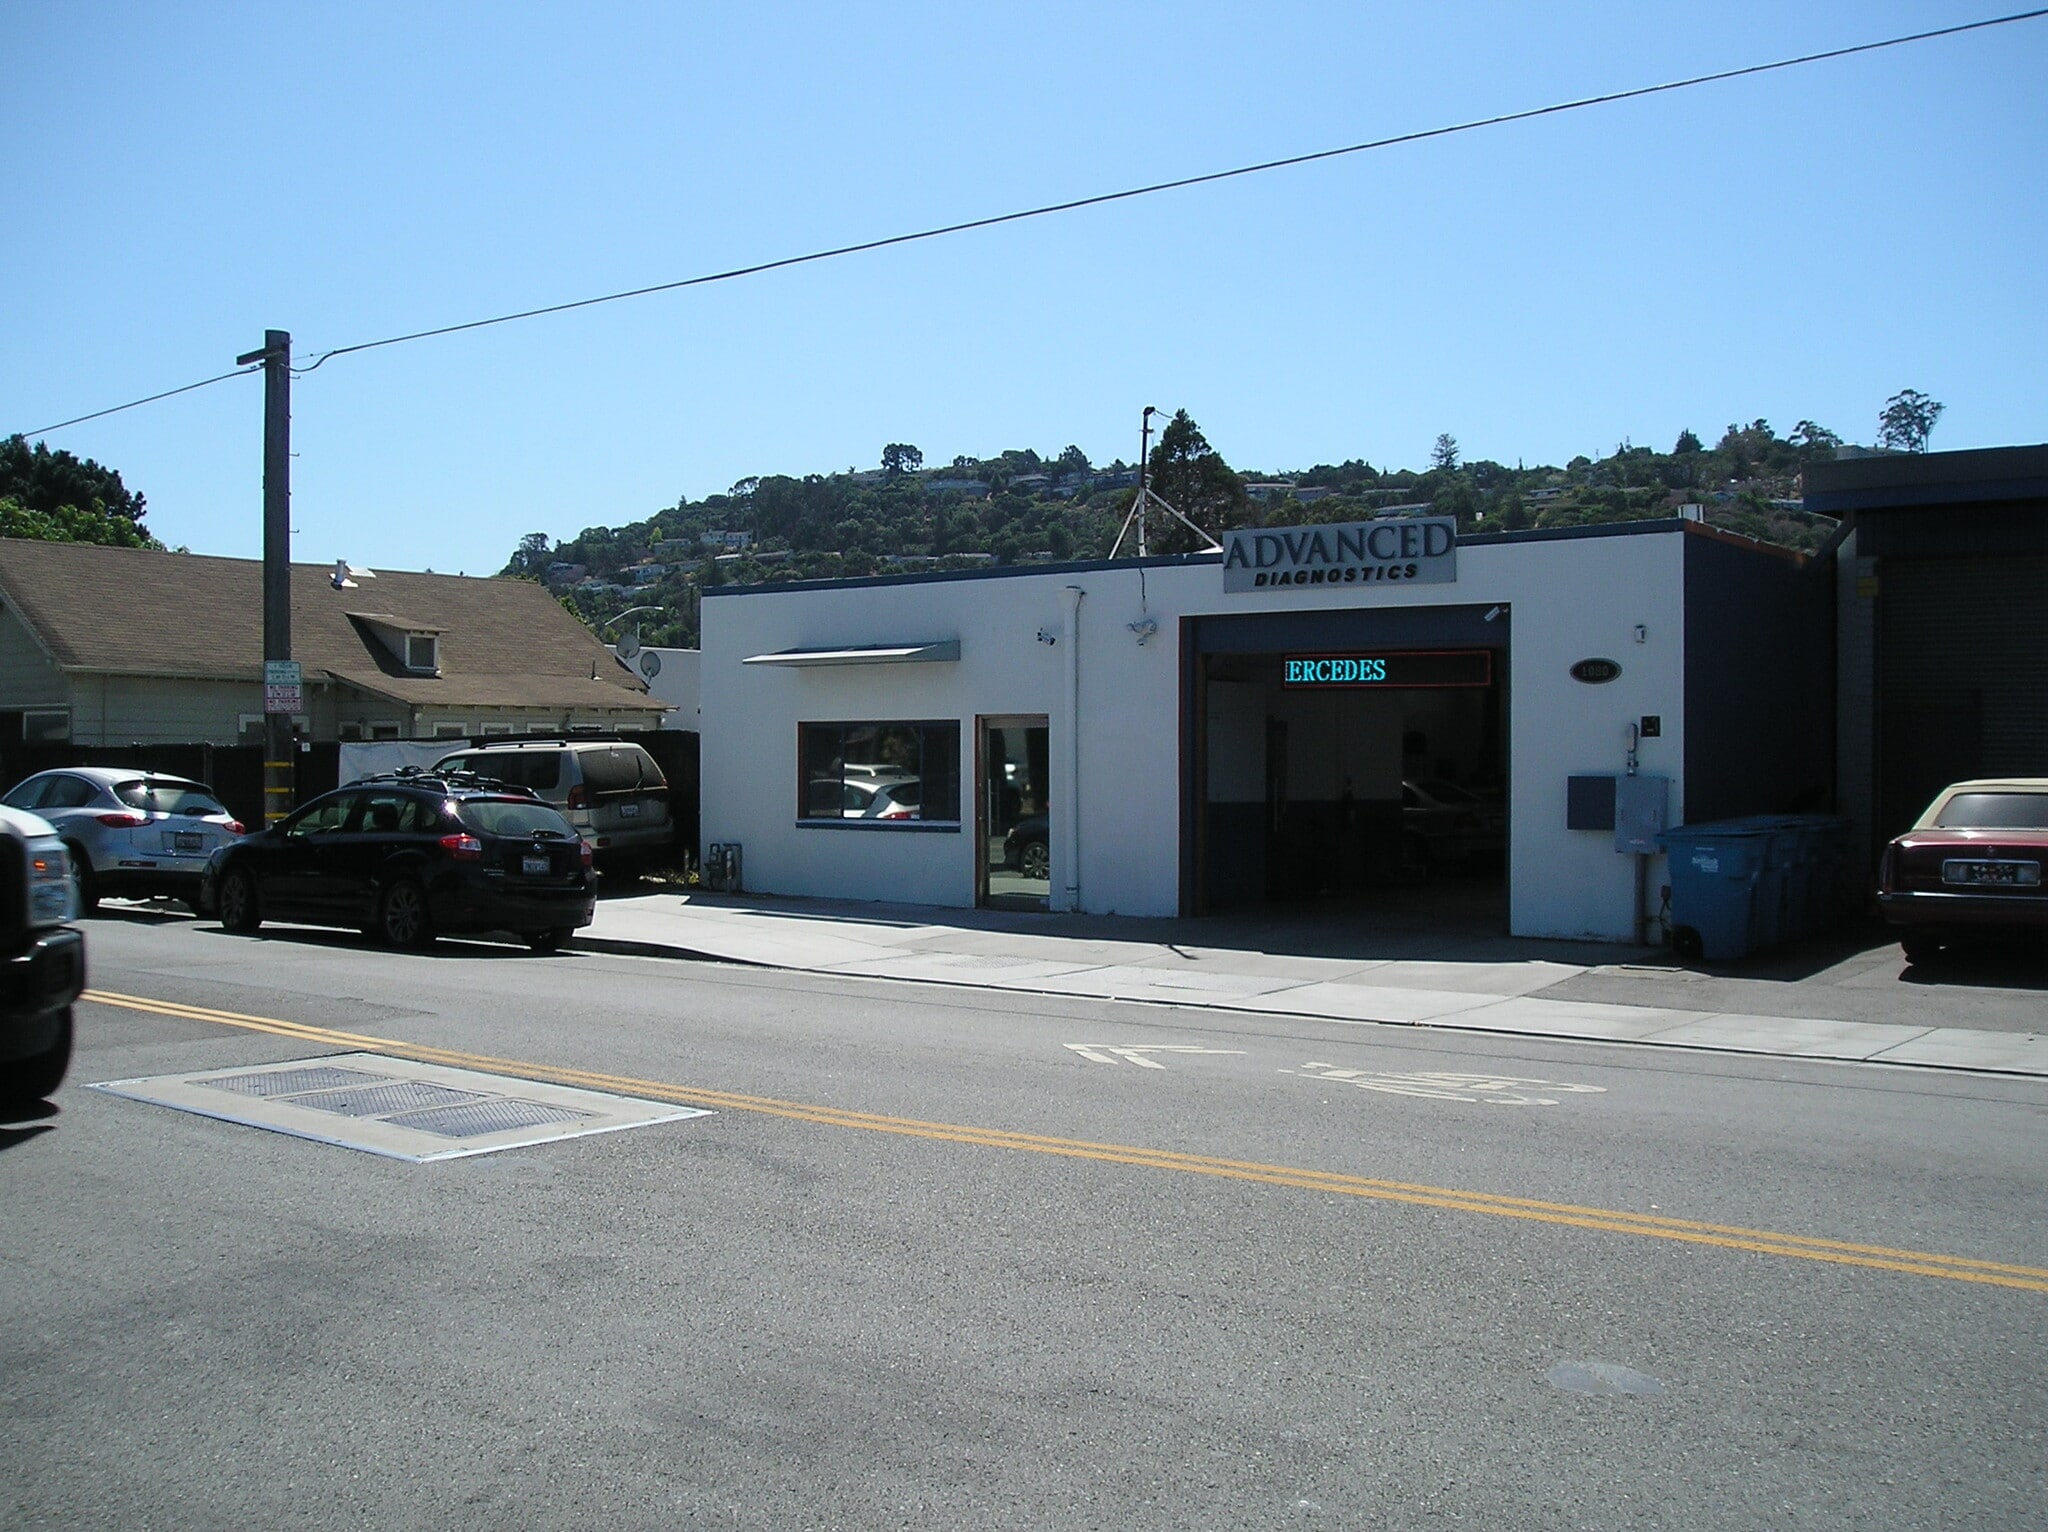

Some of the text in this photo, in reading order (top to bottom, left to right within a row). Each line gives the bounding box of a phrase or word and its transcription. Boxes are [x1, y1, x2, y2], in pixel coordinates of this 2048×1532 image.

[1224, 523, 1452, 569] ADVANCED
[1254, 563, 1418, 586] DIAGNOSTICS
[1285, 659, 1386, 682] ERCEDES
